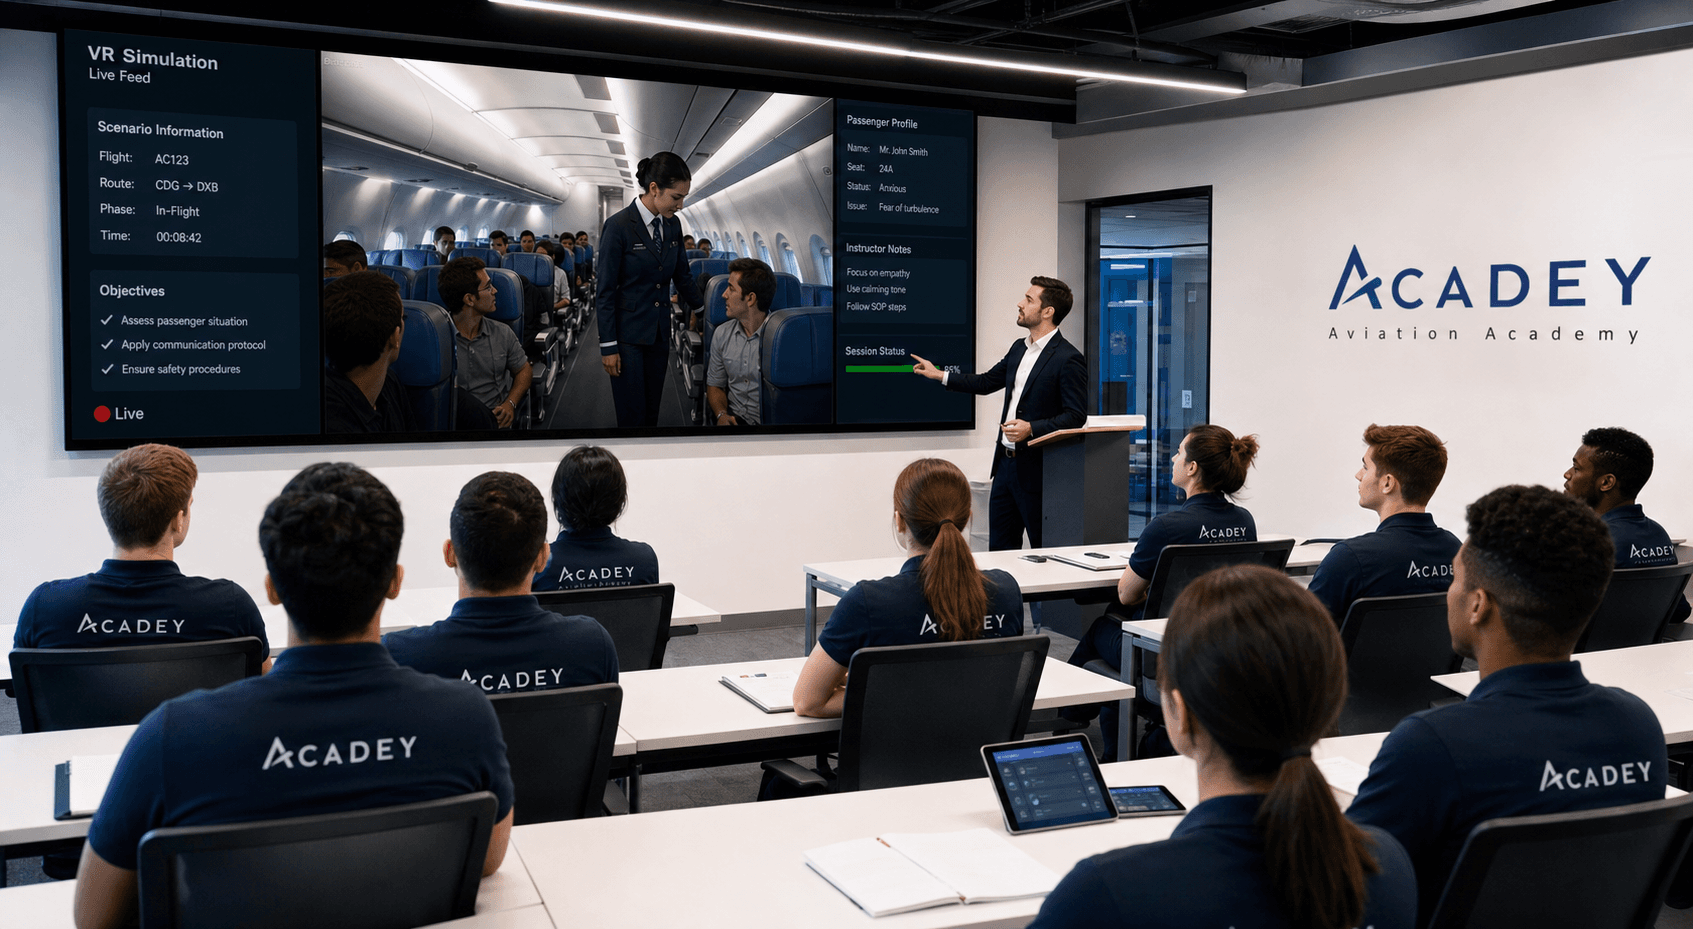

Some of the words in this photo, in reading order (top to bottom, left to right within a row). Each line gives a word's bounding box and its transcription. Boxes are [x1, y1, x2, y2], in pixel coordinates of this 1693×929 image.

[87, 45, 115, 62] VR
[122, 48, 218, 70] Simulation
[89, 67, 116, 81] Live
[119, 69, 151, 84] Feed
[846, 114, 890, 129] Passenger
[891, 117, 918, 129] Profile
[97, 120, 153, 135] Scenario
[155, 123, 224, 139] Information
[847, 143, 871, 153] Name:
[879, 145, 891, 154] Mr.
[891, 146, 908, 155] John
[908, 147, 929, 157] Smith
[99, 150, 133, 165] Flight:
[154, 153, 190, 166] AC123
[846, 161, 866, 172] Seat:
[879, 164, 894, 174] 24A
[99, 176, 135, 189] Route:
[155, 179, 180, 191] CDG
[196, 181, 219, 193] DXB
[846, 181, 872, 191] Status:
[878, 183, 907, 193] Anxious
[100, 202, 136, 215] Phase:
[156, 204, 200, 220] In-Flight
[847, 200, 868, 211] Issue:
[878, 202, 894, 212] Fear
[894, 203, 903, 212] of
[903, 203, 940, 214] turbulence
[100, 229, 131, 241] Time:
[156, 231, 202, 243] 00:08:42
[846, 242, 887, 254] Instructor
[887, 244, 912, 254] Notes
[846, 267, 869, 277] Focus
[868, 269, 879, 277] on
[879, 268, 911, 280] empathy
[1328, 244, 1652, 310] ACADEY
[99, 284, 166, 299] Objectives
[846, 284, 861, 294] Use
[861, 284, 890, 296] calming
[890, 286, 907, 294] tone
[846, 301, 871, 311] Follow
[870, 302, 888, 311] SOP
[887, 303, 907, 313] steps
[120, 314, 155, 326] Assess
[157, 317, 206, 329] passenger
[208, 316, 248, 327] situation
[1328, 327, 1458, 341] Aviation
[1484, 326, 1639, 345] Academy
[121, 339, 151, 352] Apply
[152, 339, 226, 350] communication
[227, 339, 266, 352] protocol
[845, 345, 878, 356] Session
[879, 346, 906, 356] Status
[122, 363, 155, 374] Ensure
[157, 363, 187, 376] safety
[188, 363, 241, 376] procedures
[115, 406, 145, 420] Live
[1198, 524, 1247, 539] ACADEY
[1629, 543, 1675, 559] ACADEY
[558, 566, 634, 582] ACADEY
[1406, 560, 1455, 579] ACADE
[76, 612, 185, 634] ACADEY
[920, 613, 1006, 636] AEY
[262, 735, 417, 770] ACADEY
[1539, 760, 1651, 792] ACADEY
